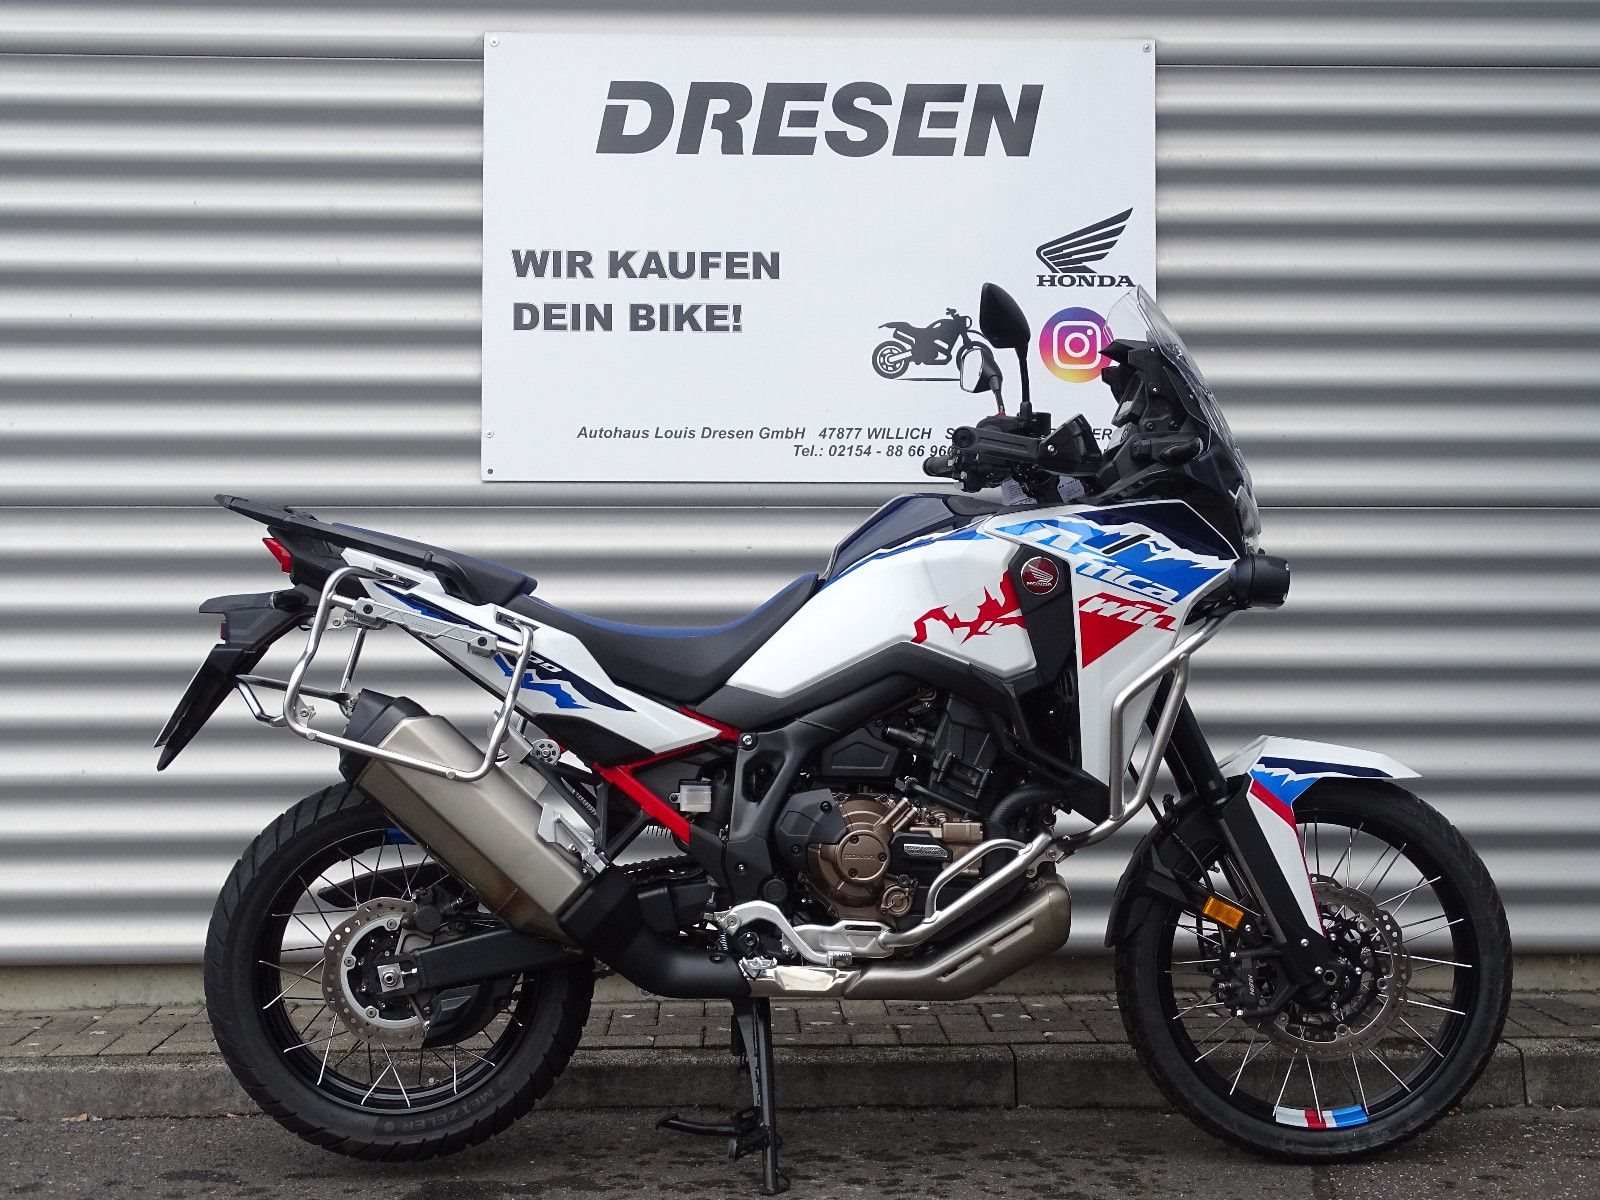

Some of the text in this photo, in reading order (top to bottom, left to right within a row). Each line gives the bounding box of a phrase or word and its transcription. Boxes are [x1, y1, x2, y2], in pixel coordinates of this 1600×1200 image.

[595, 80, 1044, 158] DRESEN
[511, 249, 780, 281] WIR KAUFEN
[1036, 274, 1136, 288] HONDA
[513, 302, 742, 333] DEIN BIKE!
[576, 426, 650, 440] Autohaus
[654, 426, 696, 440] Louis
[700, 426, 754, 440] Dresen
[758, 426, 806, 440] GmbH
[818, 427, 863, 440] 47877
[867, 427, 933, 440] WILLICH
[793, 444, 824, 457] Tel.:
[828, 444, 872, 457] 02154
[885, 445, 904, 457] 88
[907, 445, 929, 457] 66
